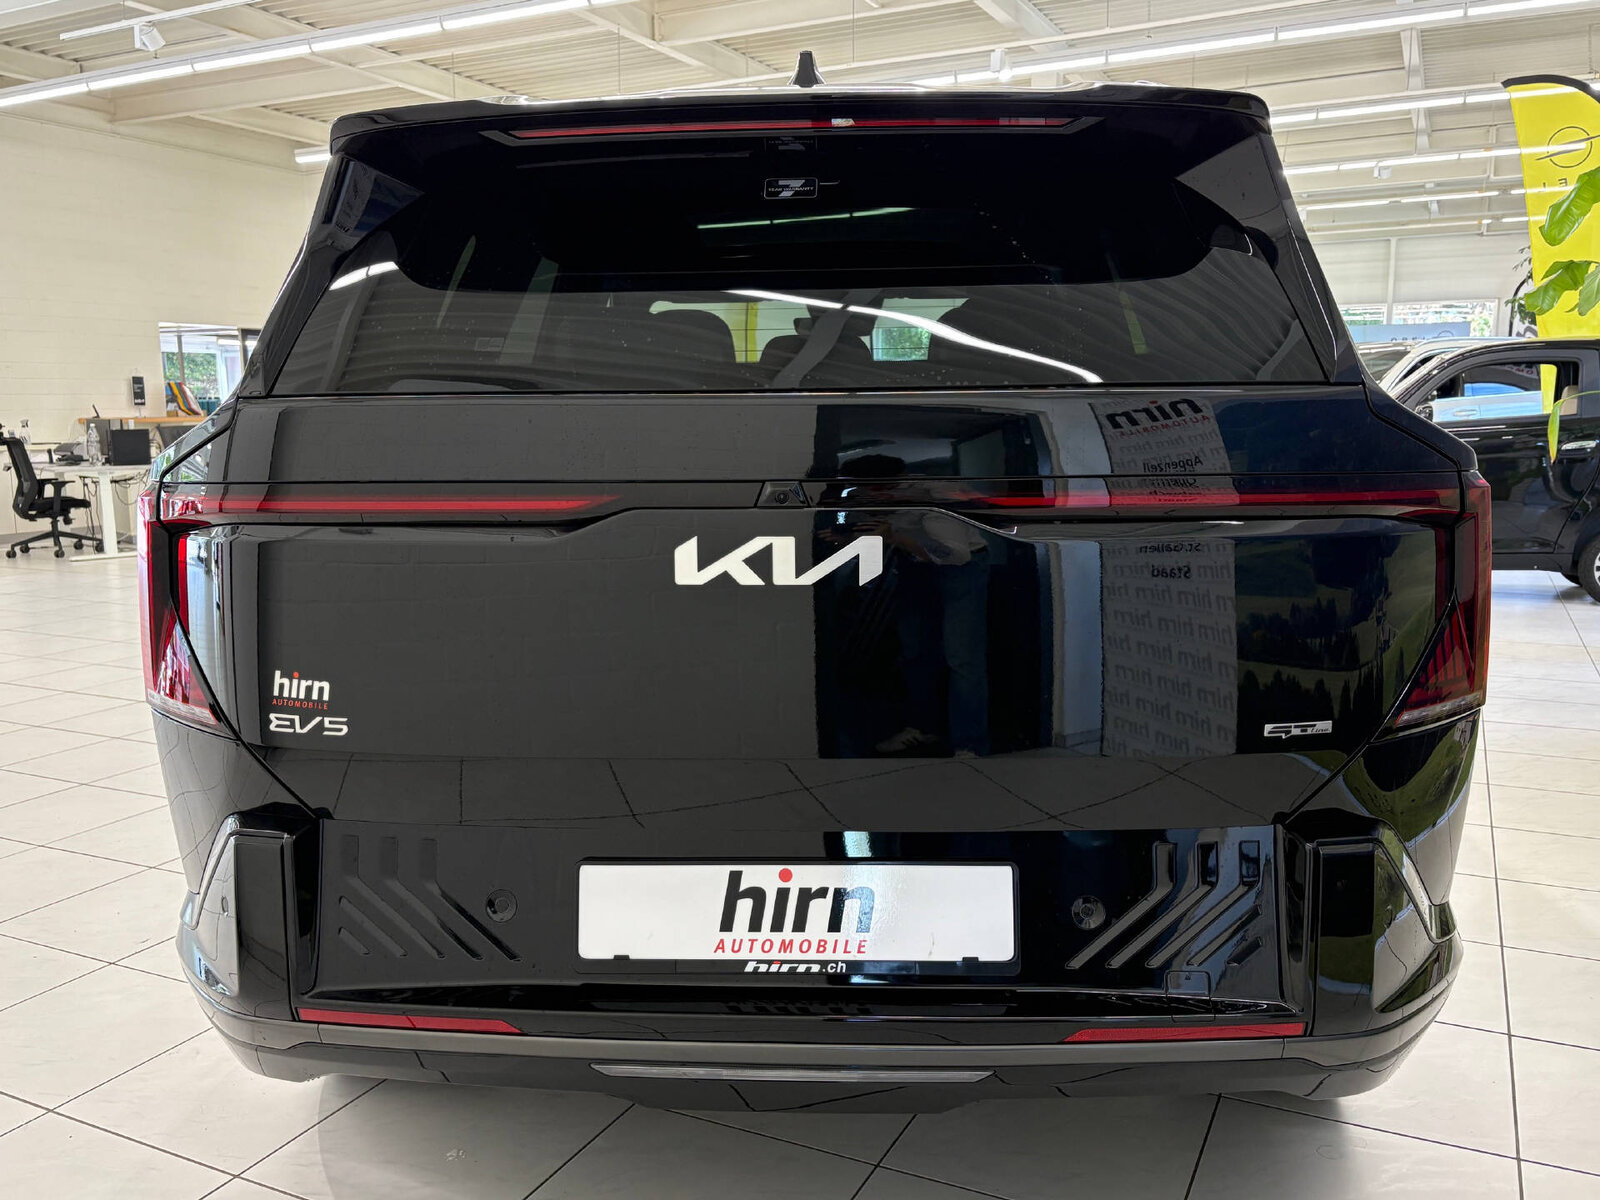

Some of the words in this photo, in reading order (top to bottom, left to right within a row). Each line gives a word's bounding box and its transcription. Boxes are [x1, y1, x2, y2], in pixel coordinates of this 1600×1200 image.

[674, 536, 883, 586] KIA
[273, 670, 330, 701] hirn
[272, 698, 328, 710] AUTOMOBILE
[269, 713, 349, 736] EV5
[719, 868, 875, 933] hirn
[714, 938, 868, 954] AUTOMOBILE
[744, 961, 847, 973] hirn.ch
